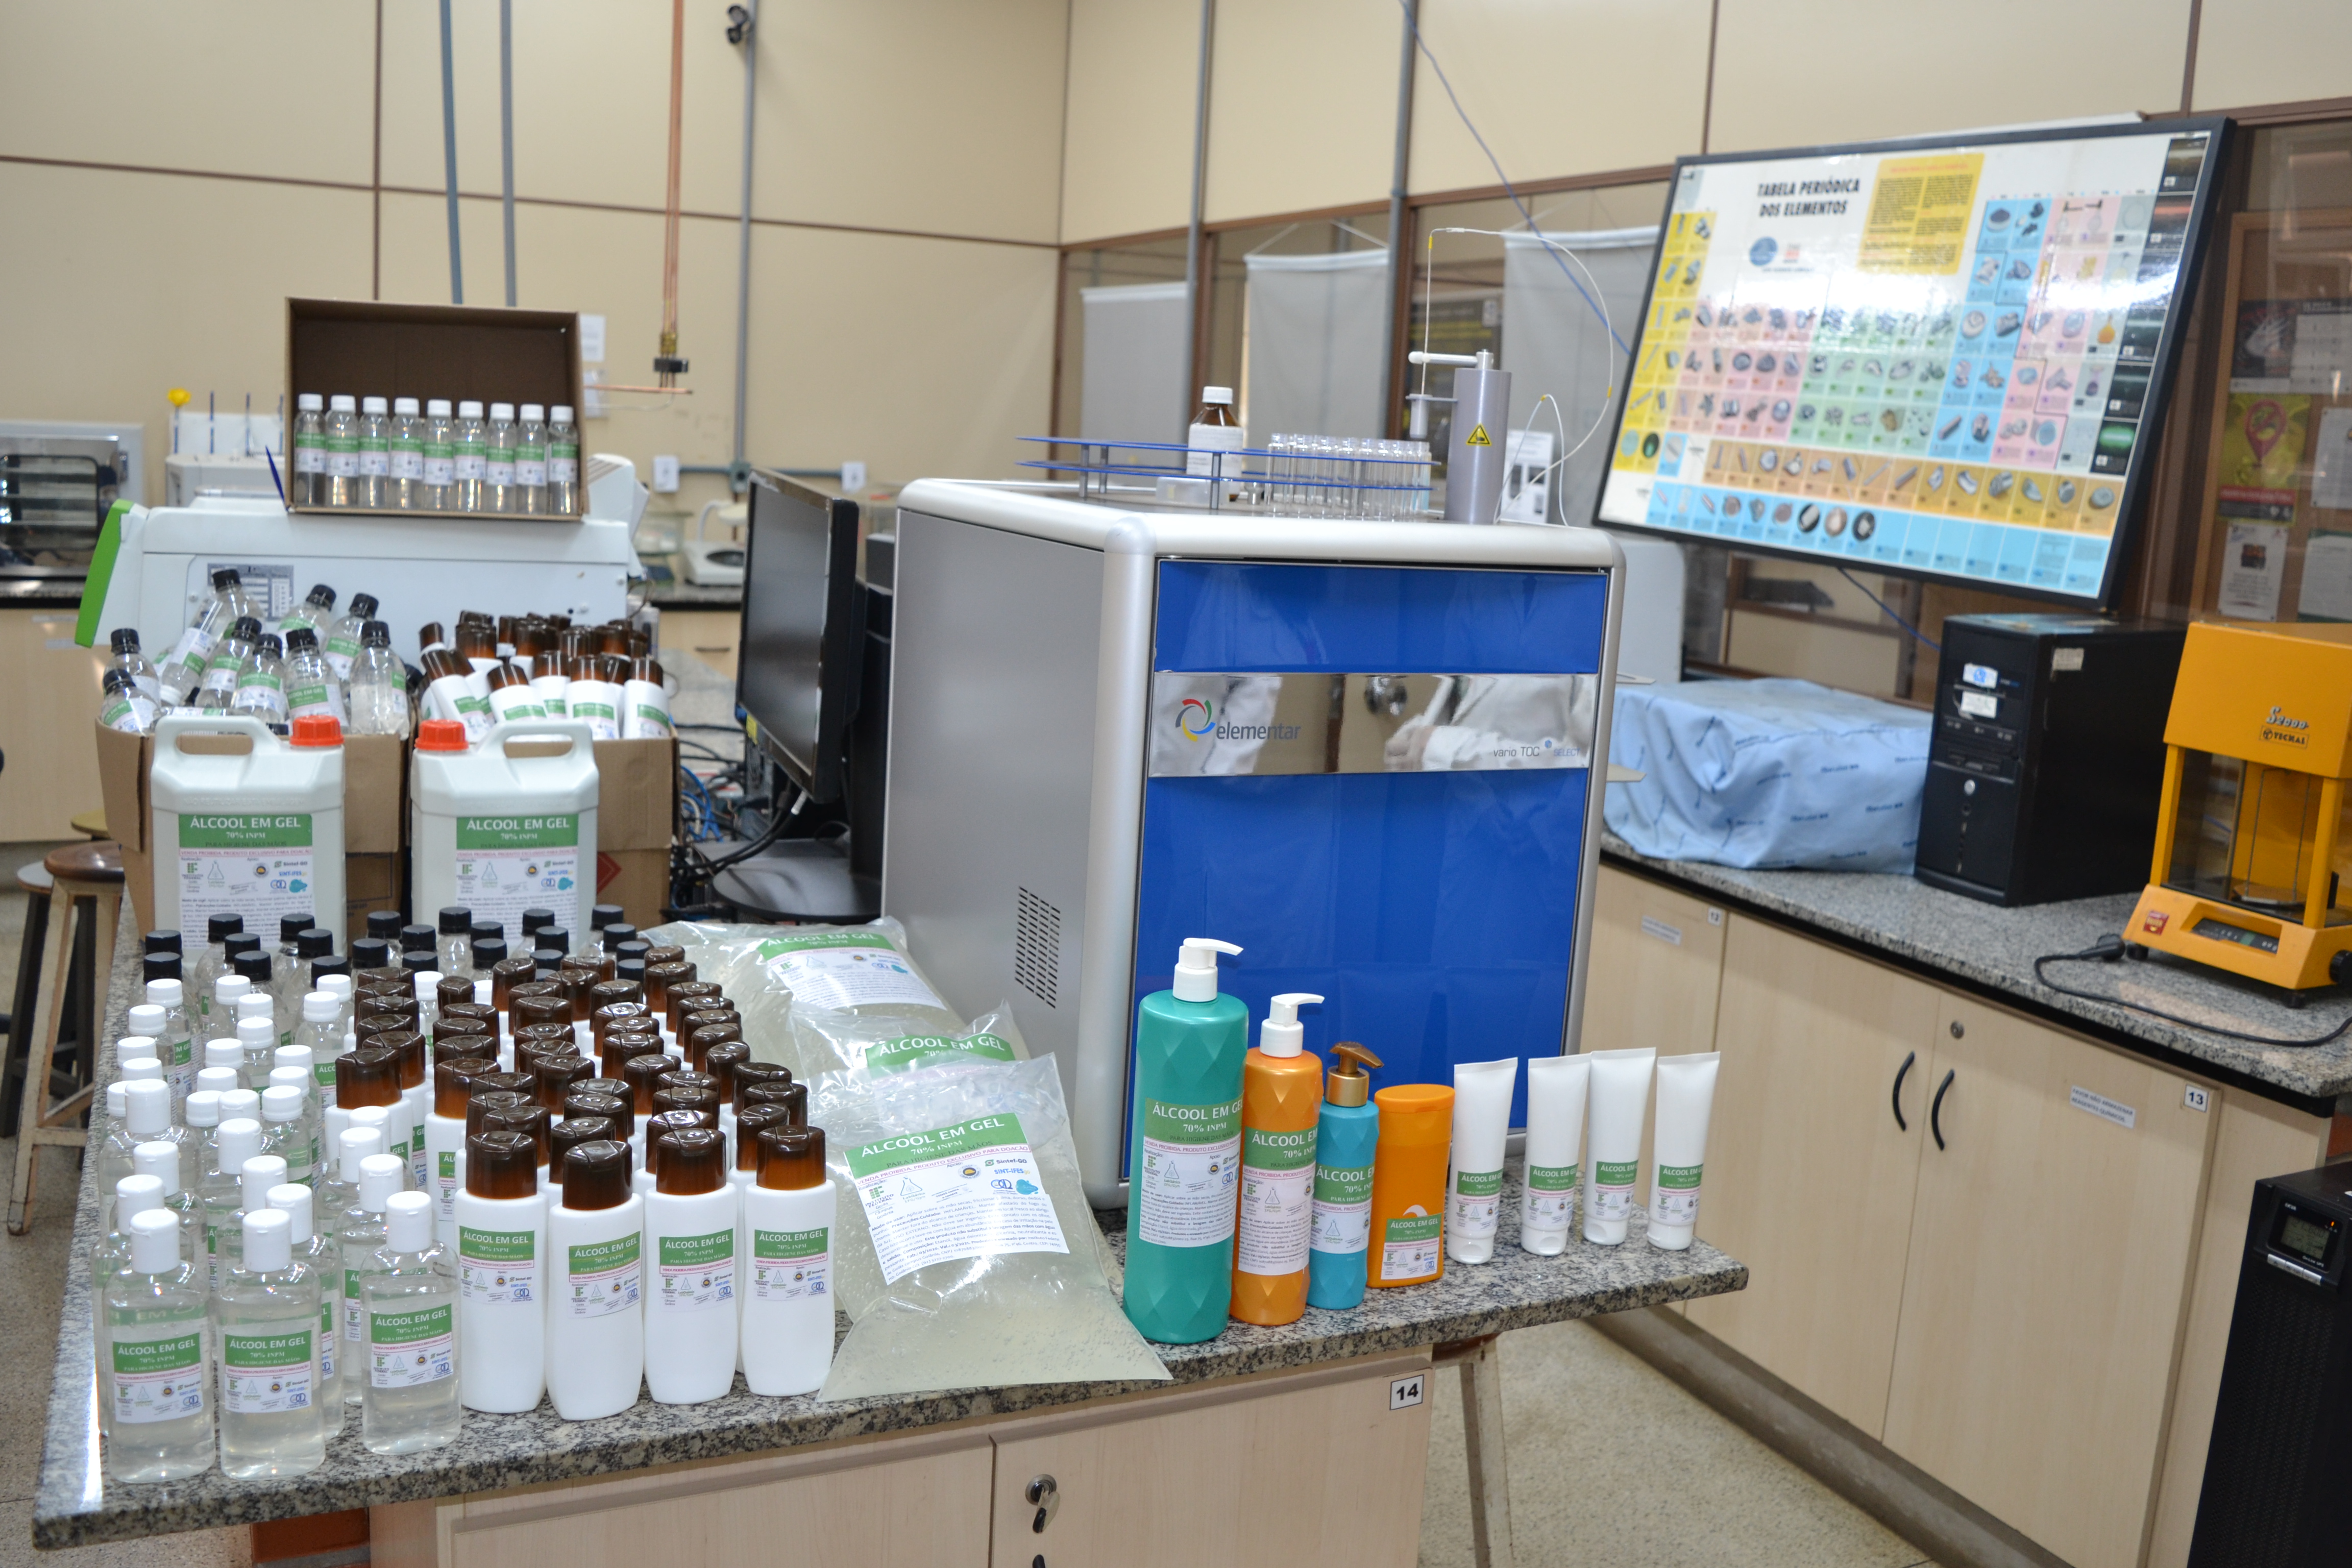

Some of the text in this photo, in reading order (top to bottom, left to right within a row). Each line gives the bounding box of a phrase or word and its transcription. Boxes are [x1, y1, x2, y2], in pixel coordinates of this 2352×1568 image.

[1757, 175, 1860, 197] TABELA PERIÓDICA
[1759, 200, 1848, 217] DOS ELEMENTOS
[2266, 706, 2309, 729] S2000
[1216, 722, 1301, 741] elementar
[1493, 746, 1580, 758] vario TOC SELECT
[190, 816, 301, 828] ÁLCOOL EM GEL
[467, 818, 569, 830] ÁLCOOL EM GEL
[768, 935, 825, 947] ÁLCOOL
[879, 1037, 1005, 1057] ÁLCOOL EM GEL
[2189, 1092, 2203, 1105] 13
[1153, 1102, 1208, 1120] ÁLCOOL
[1213, 1106, 1229, 1118] EM
[1183, 1122, 1227, 1132] 70% INPM
[862, 1118, 1004, 1157] ÁLCOOL EM GEL
[1252, 1131, 1305, 1146] ÁLCOOL
[911, 1140, 963, 1155] 70% INPM
[911, 1152, 946, 1163] HIGIENE
[969, 1140, 993, 1150] MÃOS
[1283, 1149, 1302, 1158] 70%
[857, 1175, 879, 1185] VENDA
[914, 1160, 945, 1169] PRODUTO
[947, 1152, 981, 1162] EXCLUSIVO
[1316, 1166, 1365, 1182] ÁLCOOL
[1600, 1164, 1626, 1172] ÁLCOOL
[865, 1194, 894, 1206] INSTITUTO
[869, 1197, 892, 1208] FEDERAL
[872, 1223, 885, 1232] Modo
[463, 1231, 494, 1243] ÁLCOOL
[665, 1235, 729, 1248] ÁLCOOL EM GEL
[759, 1230, 823, 1241] ÁLCOOL EM GEL
[575, 1238, 638, 1257] ÁLCOOL EM GEL
[609, 1254, 623, 1262] INPM
[376, 1309, 448, 1326] ÁLCOOL EM GEL
[118, 1340, 195, 1356] ÁLCOOL EM GEL
[230, 1336, 306, 1349] ÁLCOOL EM GEL
[1396, 1383, 1418, 1401] 14
